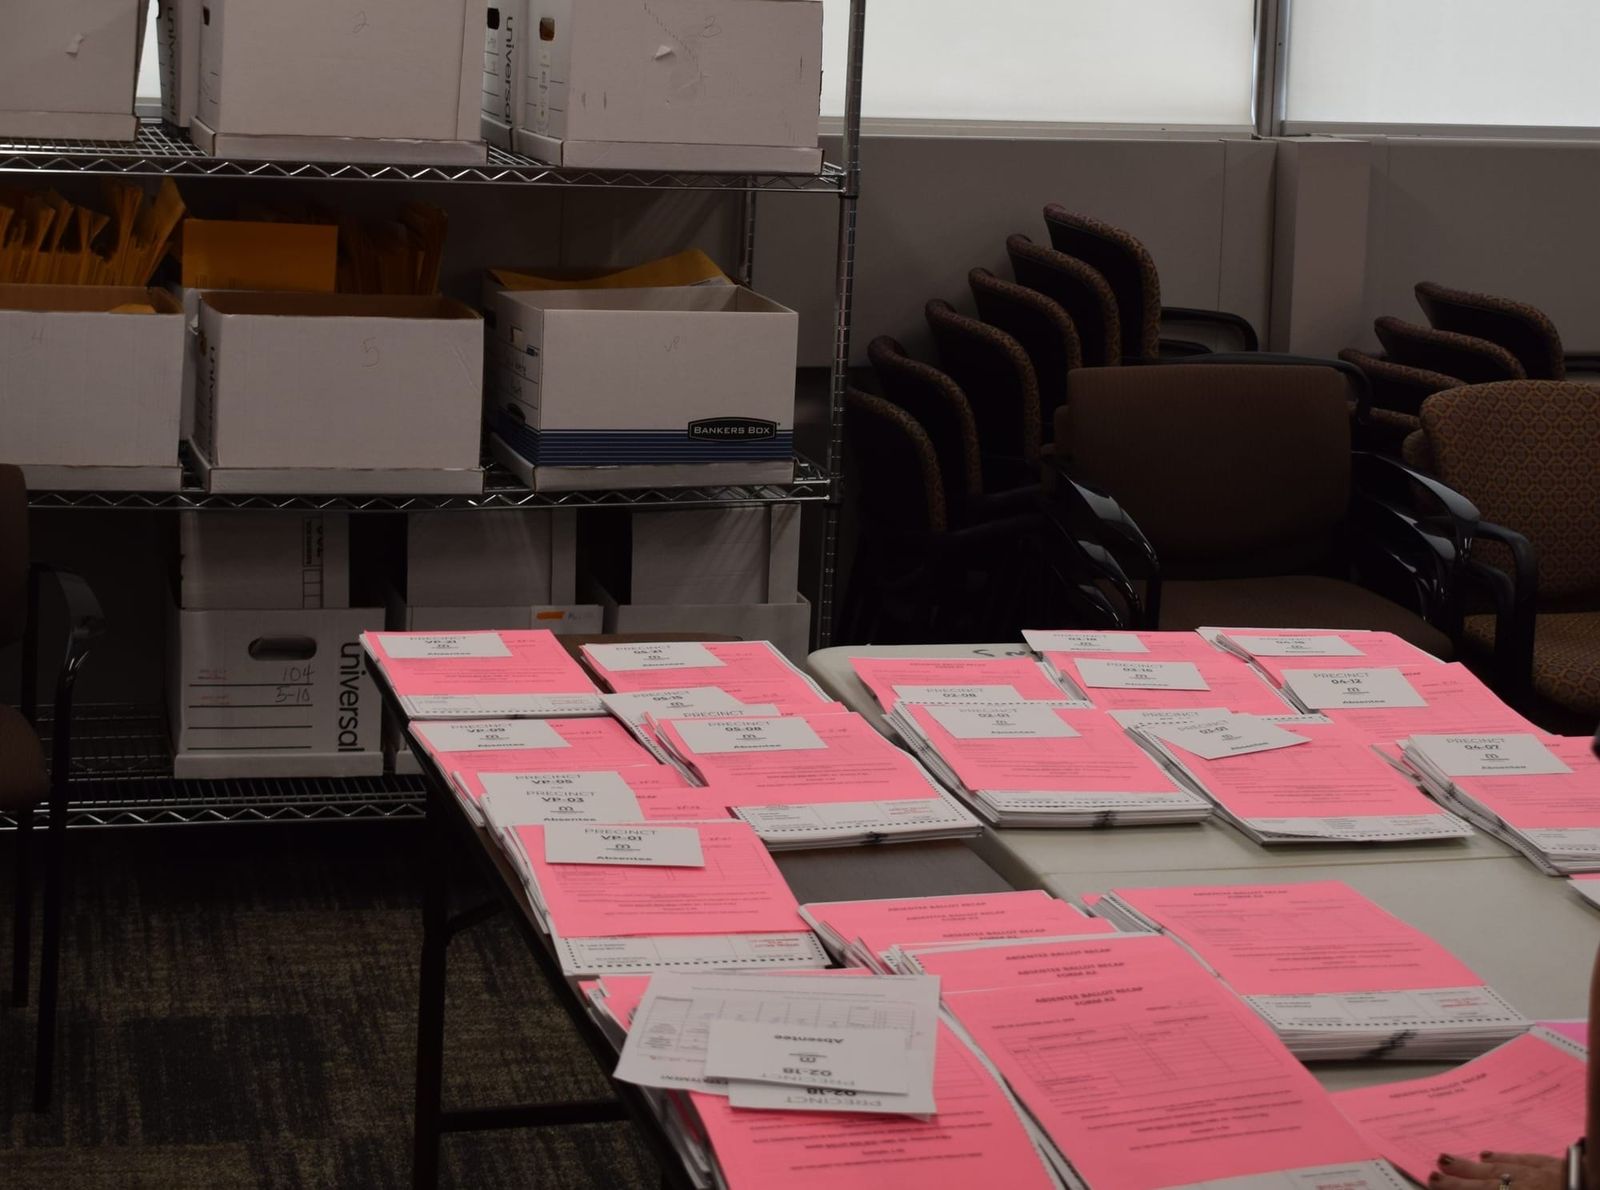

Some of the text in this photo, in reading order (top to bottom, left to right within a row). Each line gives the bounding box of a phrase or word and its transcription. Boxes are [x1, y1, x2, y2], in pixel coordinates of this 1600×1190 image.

[503, 16, 514, 124] universal
[361, 336, 380, 367] 5
[694, 425, 771, 435] BANKERS BOX
[337, 642, 366, 752] universal
[683, 710, 744, 718] PRECINCT
[774, 1034, 844, 1044] Absentee
[782, 1067, 832, 1077] 02-18
[761, 1073, 855, 1086] PRECINCT
[785, 1096, 882, 1107] PRECINCT
